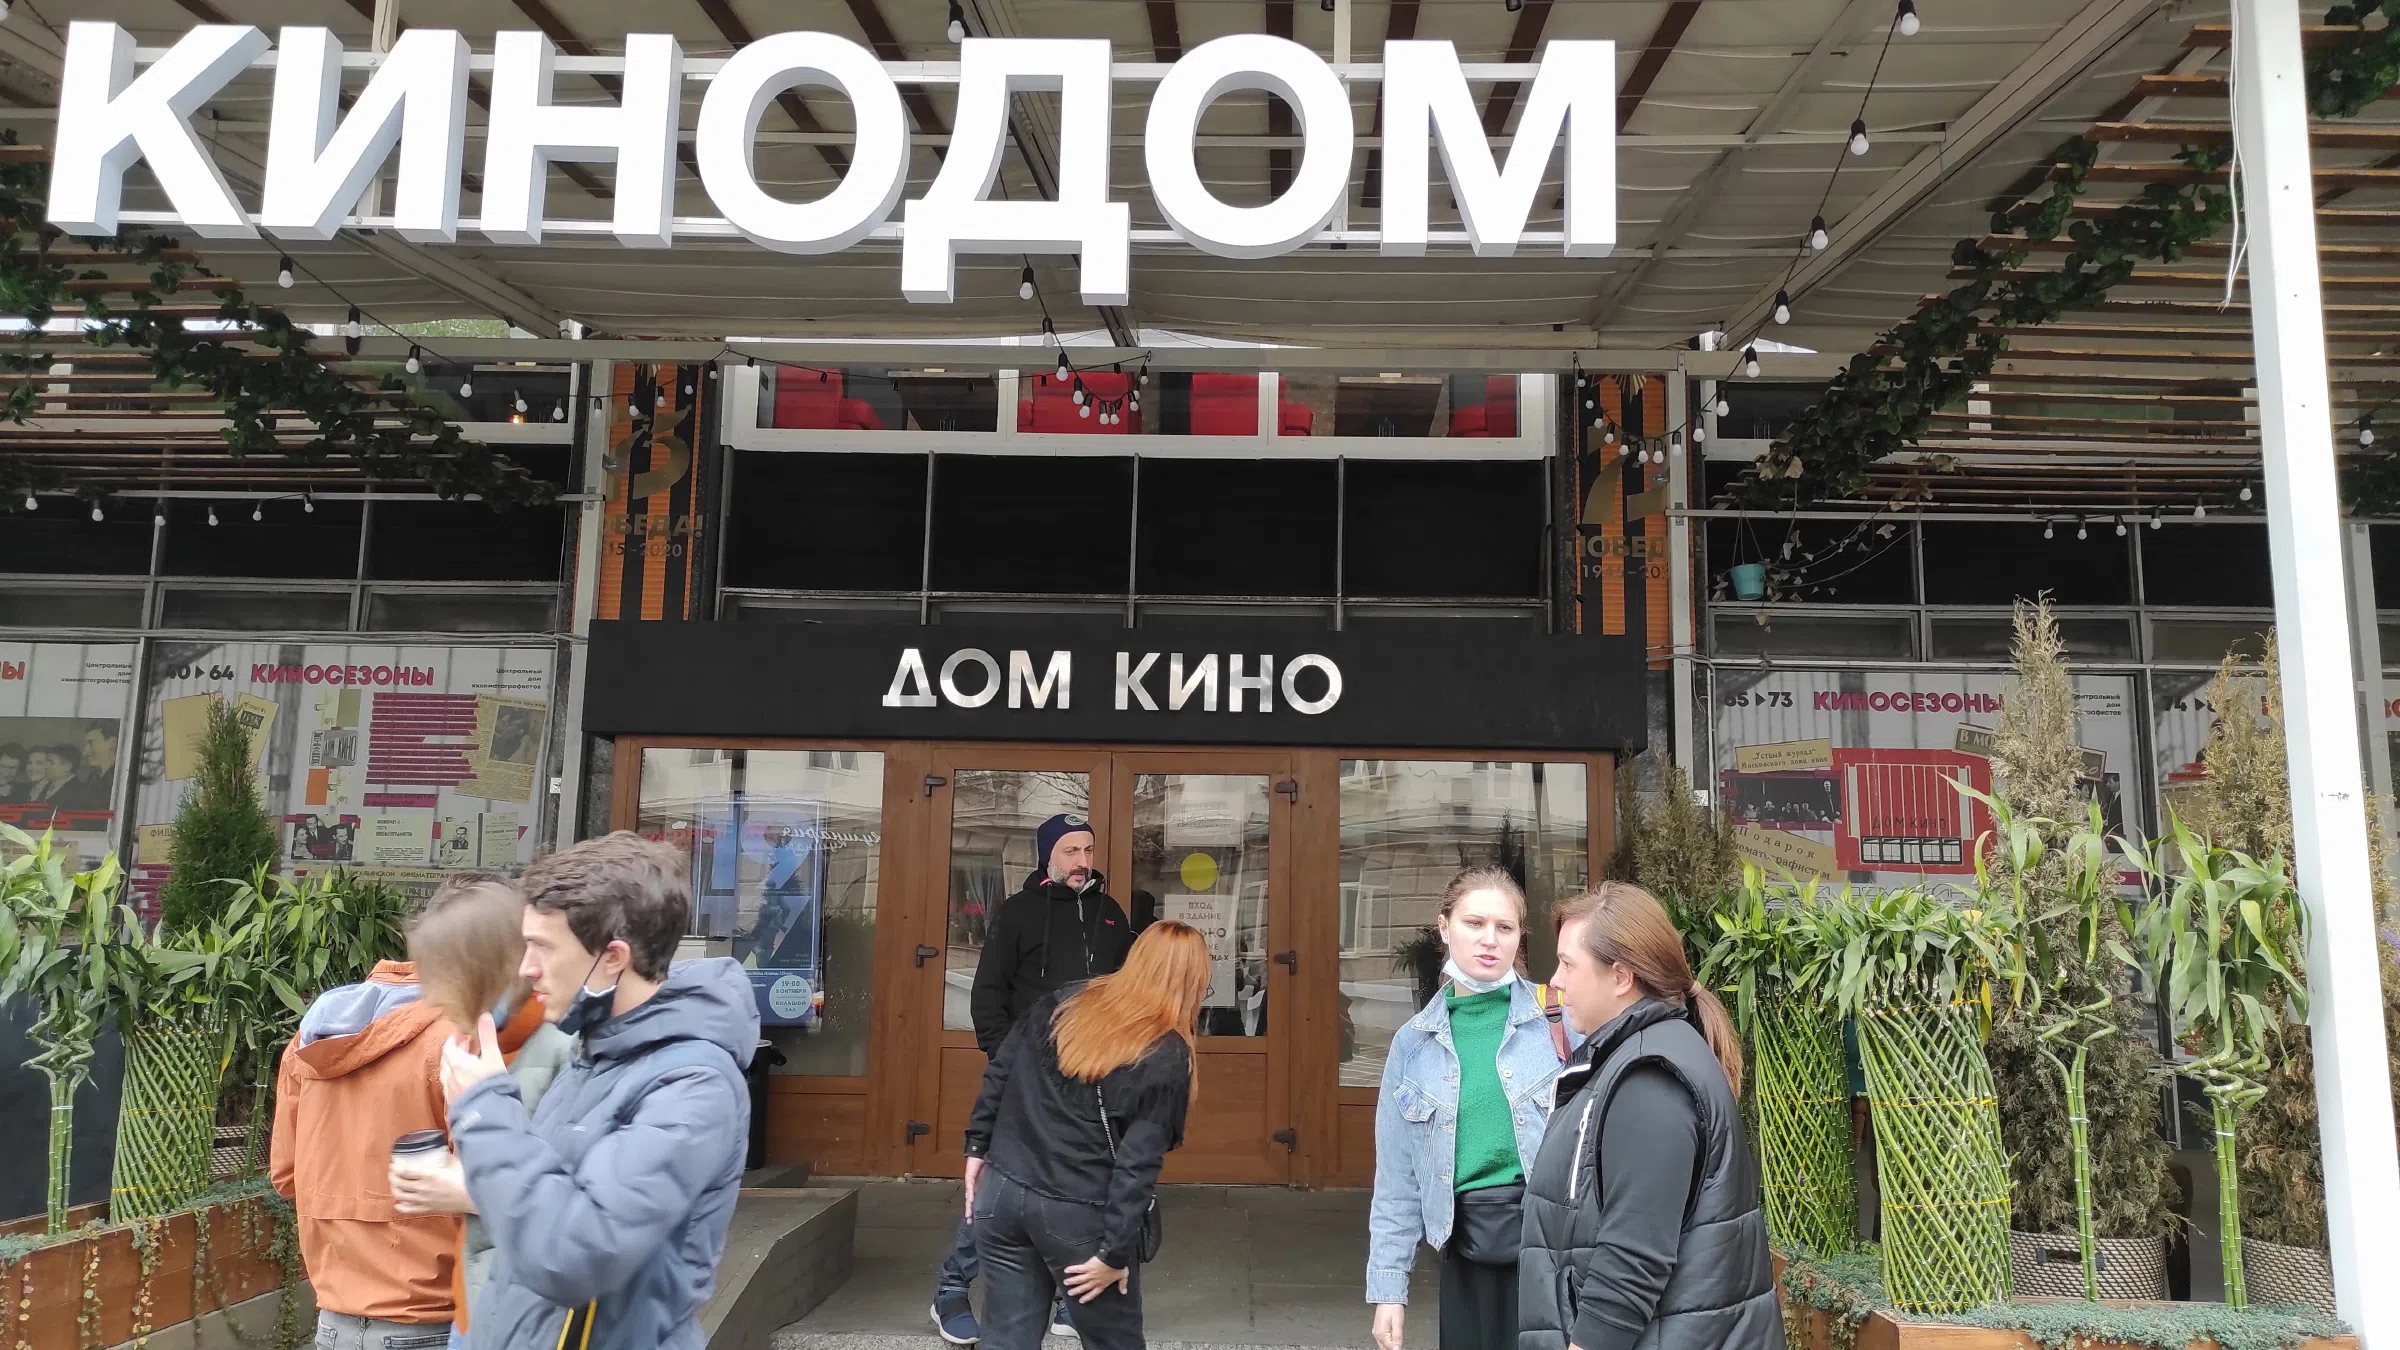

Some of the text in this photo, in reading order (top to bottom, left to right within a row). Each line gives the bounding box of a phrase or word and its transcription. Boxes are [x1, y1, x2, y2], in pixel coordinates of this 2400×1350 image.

[47, 21, 1617, 304] КИНОДОМ
[209, 665, 235, 680] 64
[251, 664, 434, 686] КИНОСЕЗОНЫ
[882, 648, 1343, 714] ДОМ КИНО
[1767, 692, 1794, 708] 73
[2074, 693, 2121, 701] ентральный
[1959, 730, 1969, 743] В
[1741, 760, 1786, 769] Московского
[1872, 818, 1947, 831] ДОМ КИНО
[1738, 826, 1816, 859] Подарок
[1188, 901, 1213, 910] ВХОД
[1179, 912, 1222, 920] В ЗДАНИЕ
